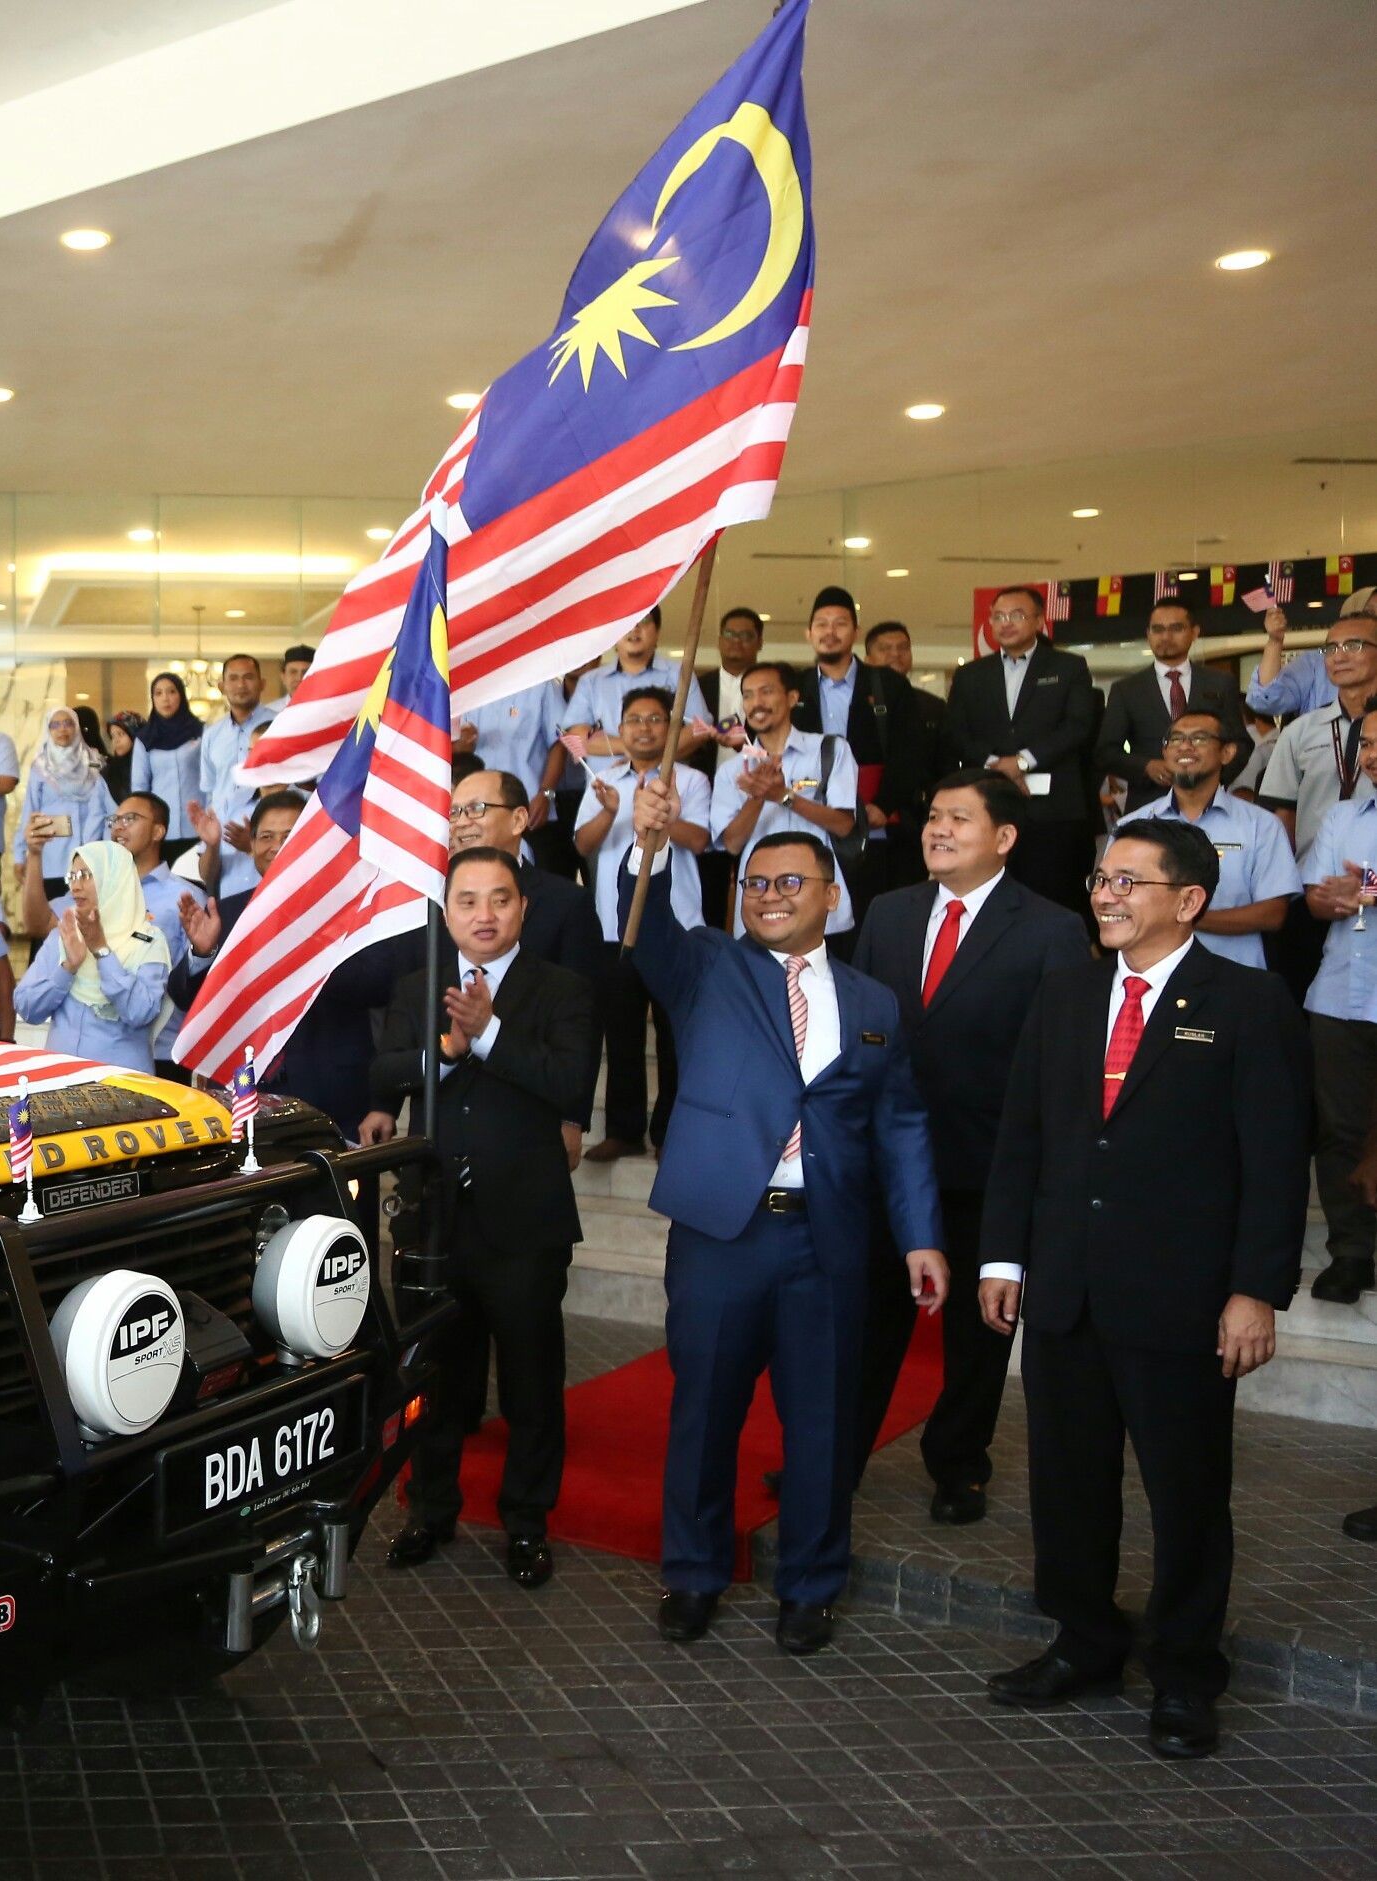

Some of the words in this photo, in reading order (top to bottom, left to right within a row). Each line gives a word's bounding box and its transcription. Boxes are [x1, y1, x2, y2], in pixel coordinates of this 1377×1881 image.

[82, 1116, 227, 1161] ROVER
[49, 1178, 133, 1209] DEFENDER
[324, 1252, 361, 1280] IPF
[334, 1284, 356, 1296] SPORT
[119, 1310, 169, 1351] IPF
[134, 1347, 164, 1366] SPORT
[205, 1436, 264, 1510] BDA
[274, 1407, 335, 1477] 6172
[254, 1499, 267, 1511] Land
